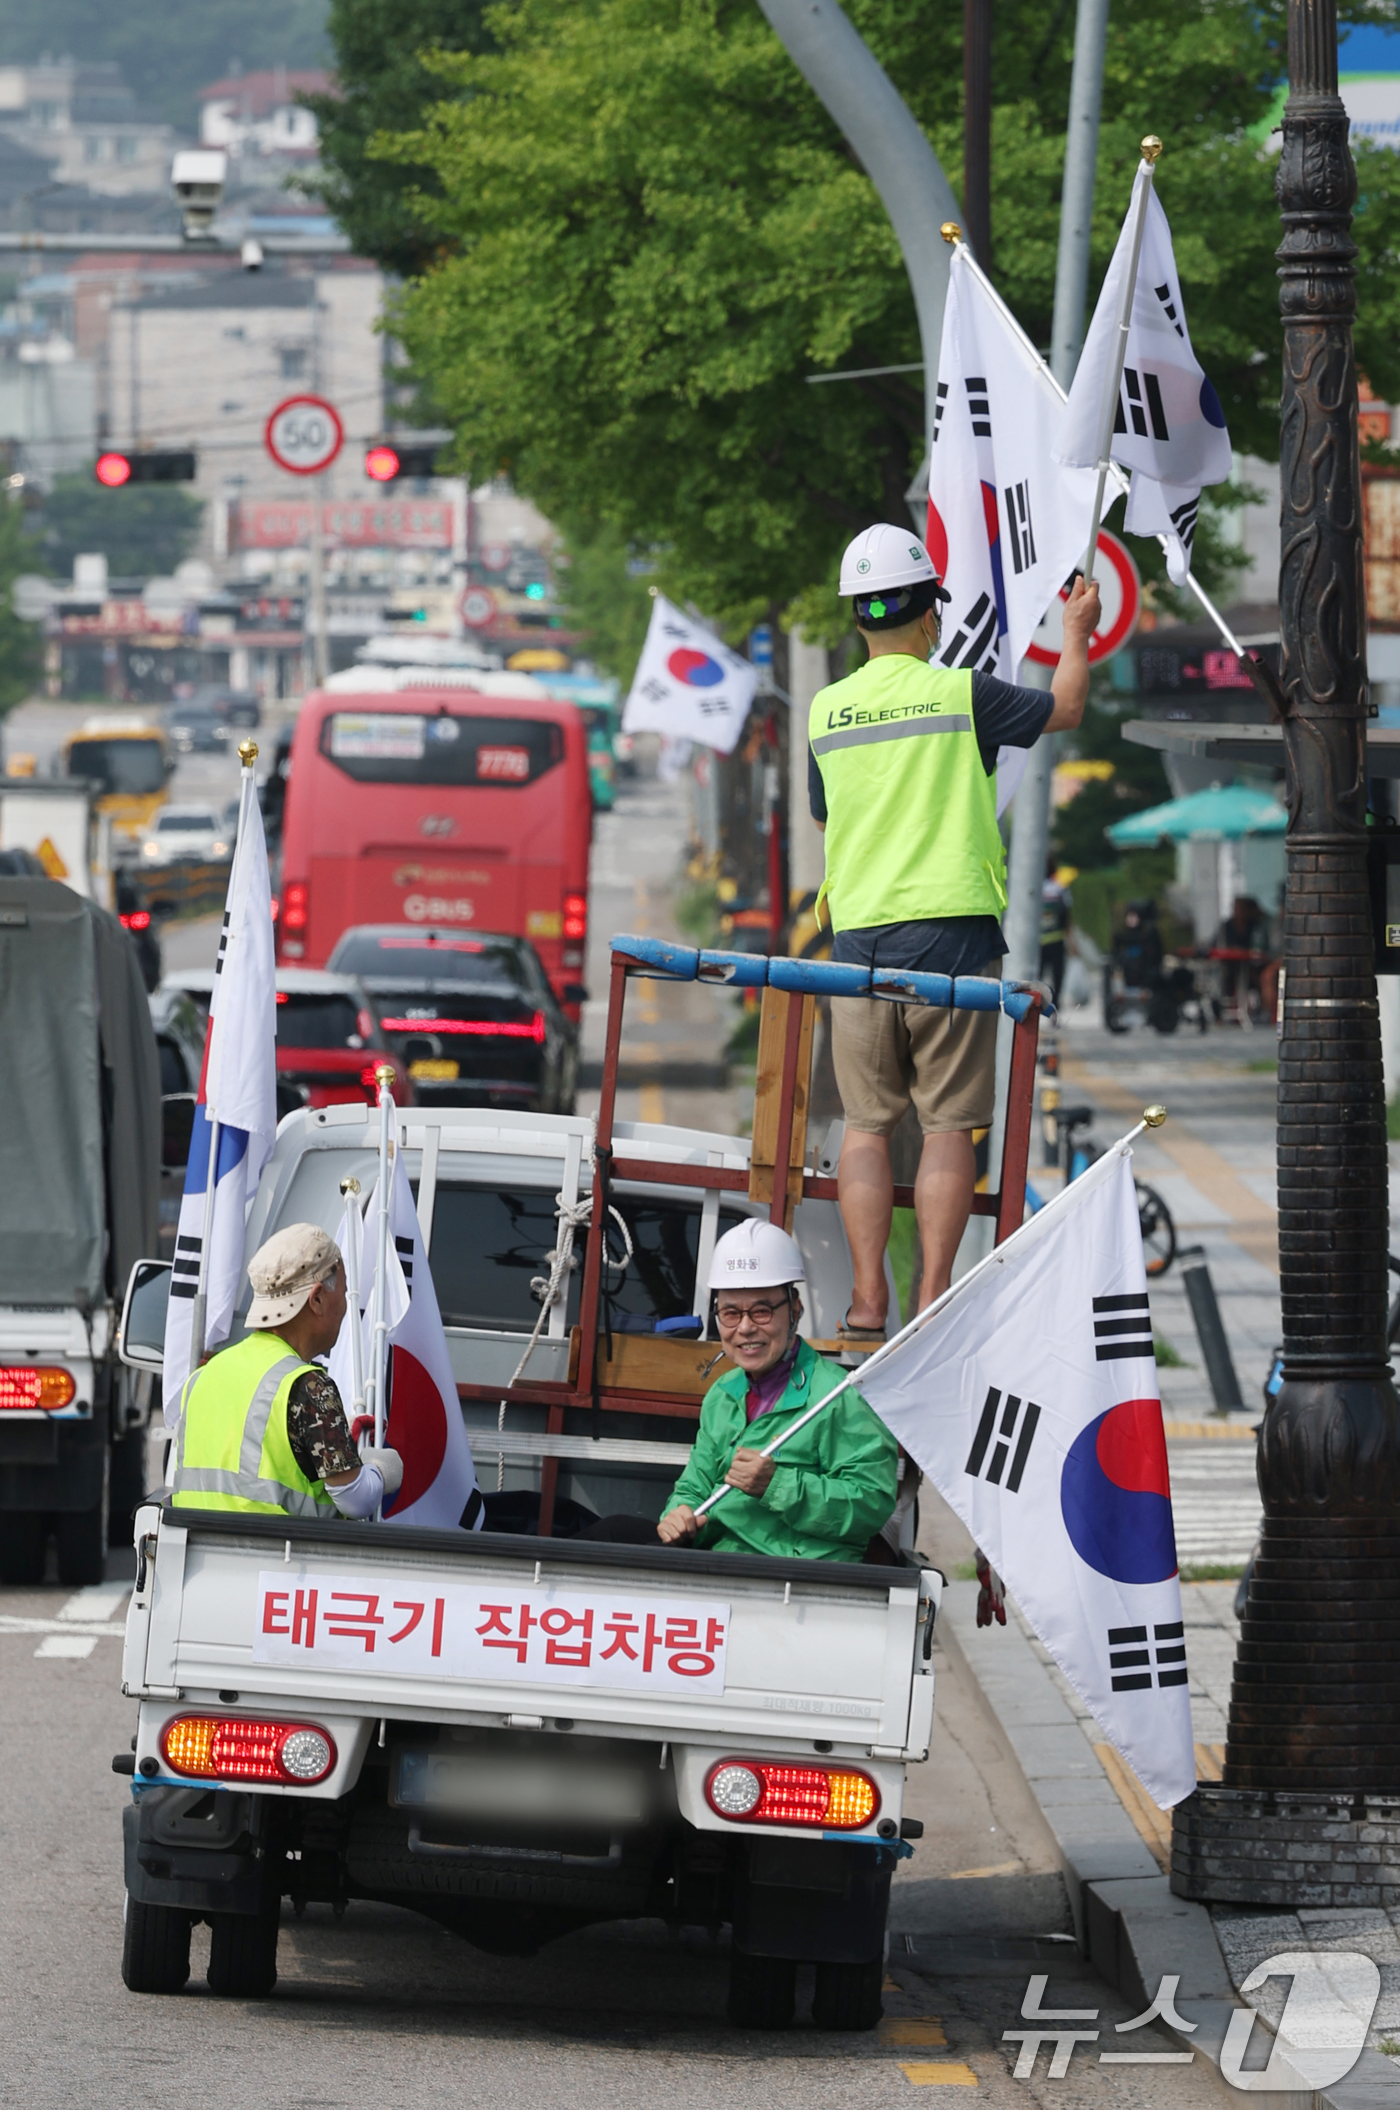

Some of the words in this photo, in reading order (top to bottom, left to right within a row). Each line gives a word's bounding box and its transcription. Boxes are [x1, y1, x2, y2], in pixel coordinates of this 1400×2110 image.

[282, 417, 326, 450] 50
[827, 706, 853, 730] LS
[855, 702, 942, 725] ELECTRIC
[726, 1258, 759, 1271] 영화동
[261, 1588, 446, 1658] 태극기
[474, 1603, 725, 1678] 작업차량
[762, 1696, 824, 1713] 최대적재량
[829, 1702, 872, 1717] 1000kg
